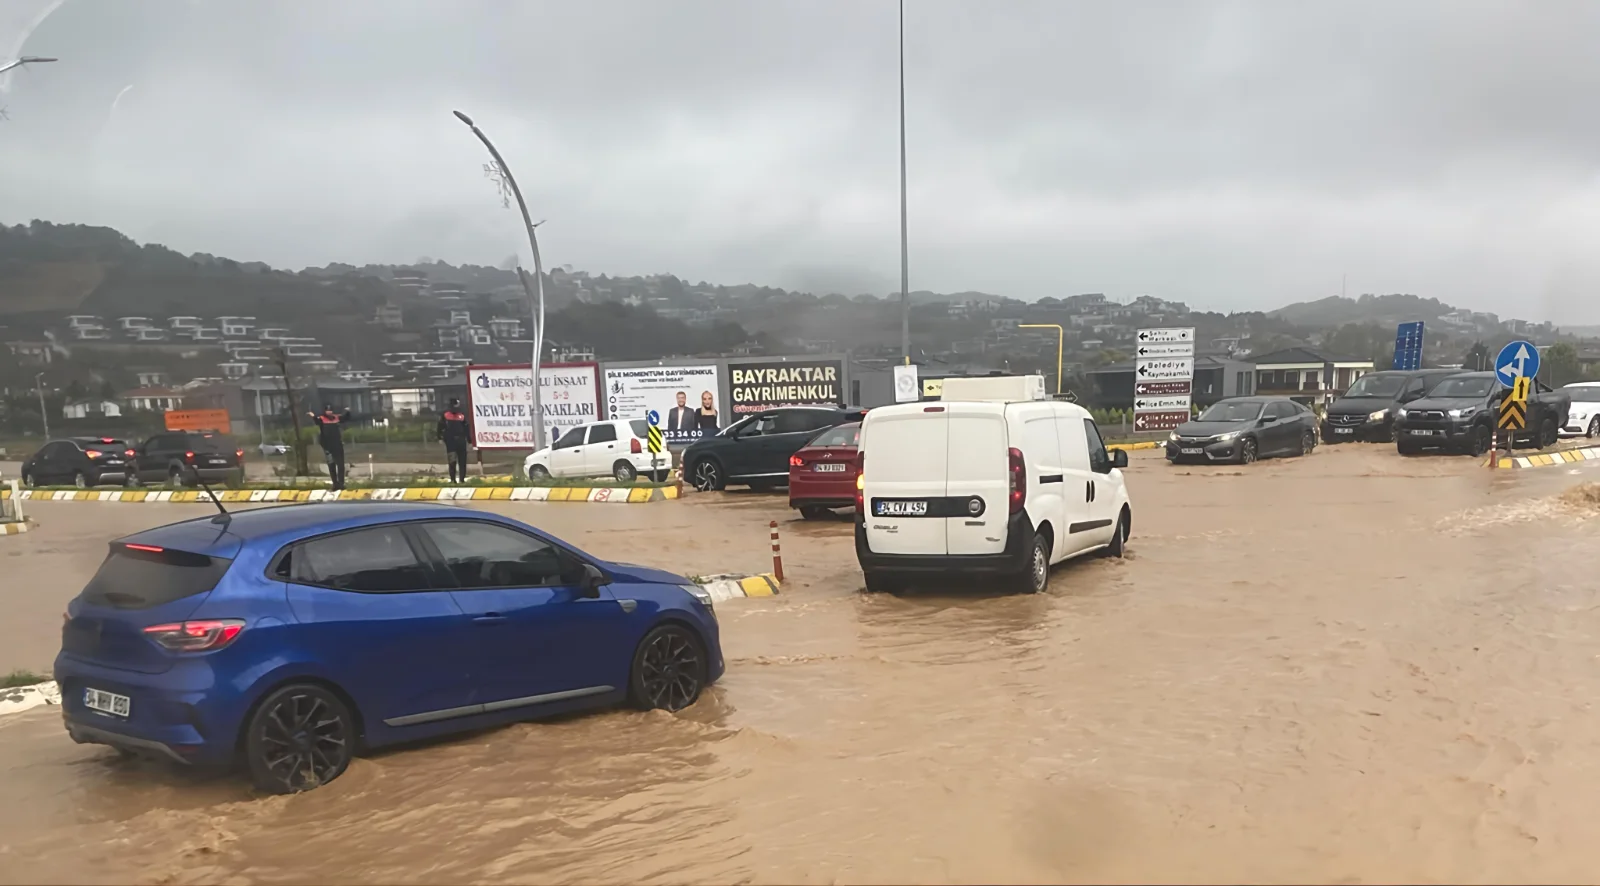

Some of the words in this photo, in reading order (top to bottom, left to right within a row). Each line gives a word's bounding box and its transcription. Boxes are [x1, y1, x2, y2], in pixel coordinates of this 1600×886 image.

[1147, 361, 1185, 370] Belediye
[607, 371, 622, 379] ŞİLE
[622, 369, 665, 378] MOMENTUM
[665, 368, 714, 377] GAYRİMENKUL
[732, 366, 837, 384] BAYRAKTAR
[1147, 370, 1190, 379] Kaymakamlık
[491, 375, 551, 389] DERVİŞOLU
[553, 374, 588, 389] İNŞAAT
[733, 383, 837, 402] GAYRİMENKUL
[475, 404, 526, 417] NEWLIFE
[478, 431, 501, 443] 0532
[502, 431, 520, 443] 652
[677, 430, 688, 438] 34
[690, 429, 703, 437] 00
[881, 502, 890, 511] 34
[893, 502, 907, 511] CVA
[911, 502, 926, 511] 494
